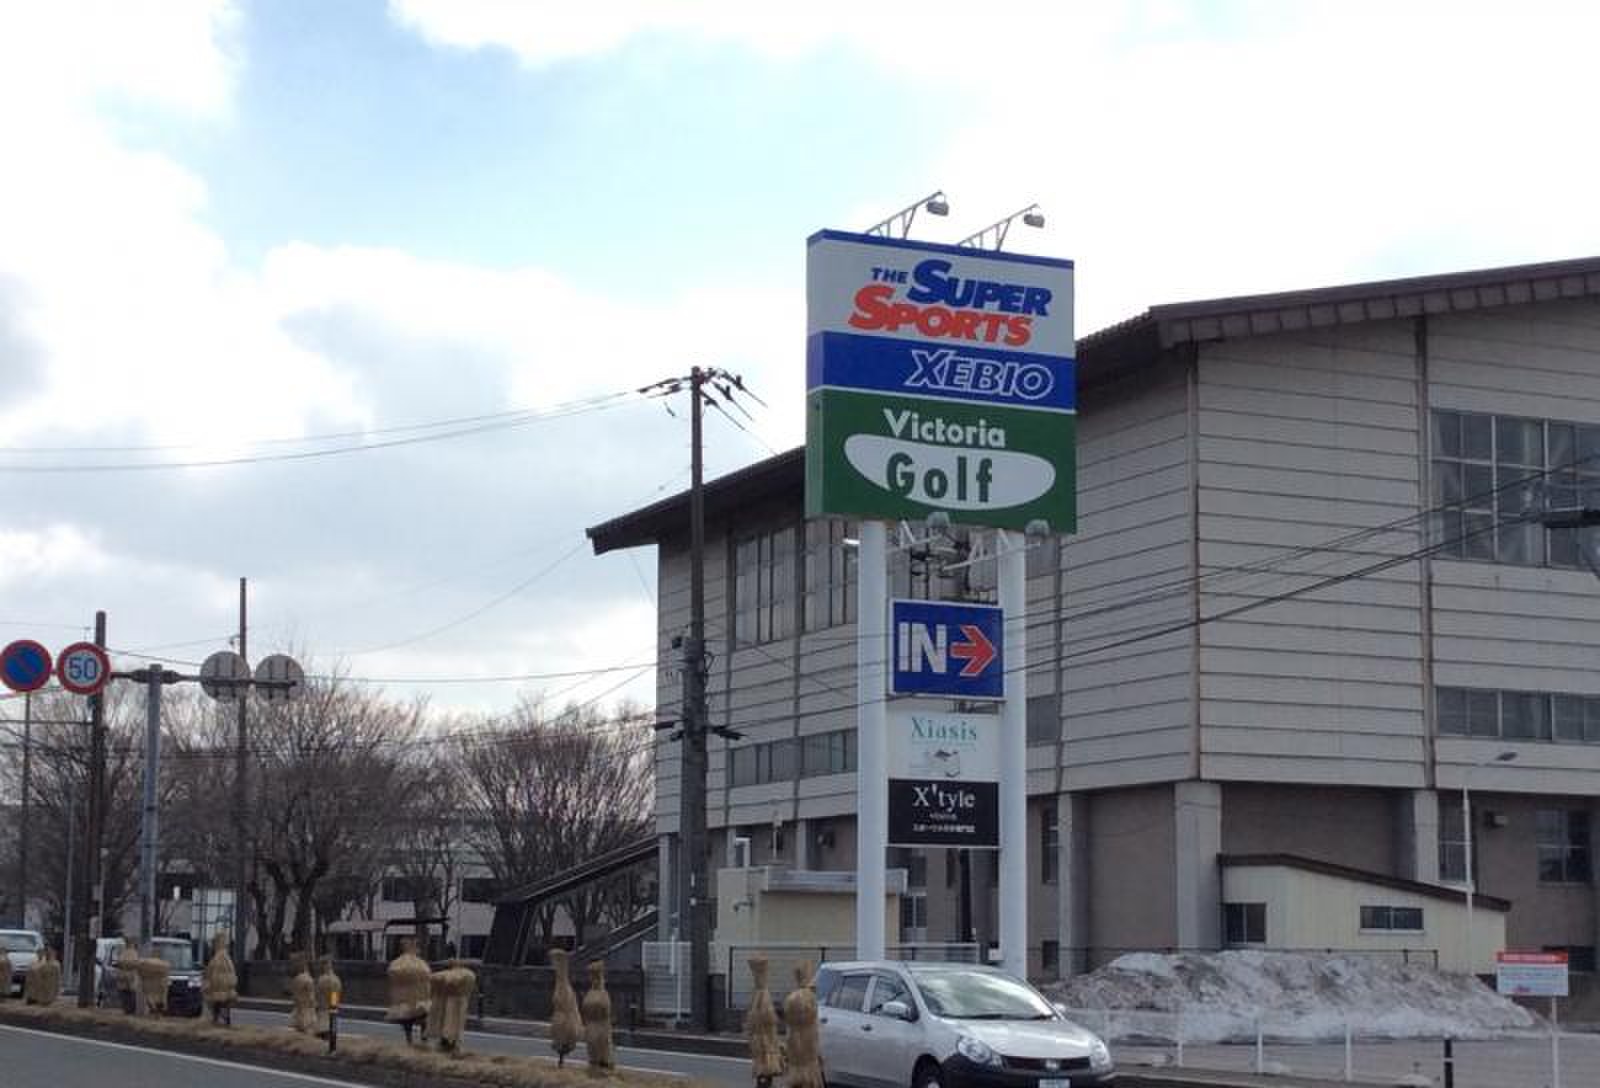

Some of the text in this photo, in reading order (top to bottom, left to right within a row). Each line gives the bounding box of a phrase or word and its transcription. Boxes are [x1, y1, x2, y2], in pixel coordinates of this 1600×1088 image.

[871, 259, 1053, 317] THE SUPER
[848, 284, 1033, 347] SPORTS
[904, 350, 1055, 400] XEBIO
[882, 408, 1006, 448] Victoria
[886, 452, 993, 503] Golf
[68, 656, 98, 680] 50
[897, 621, 948, 674] IN
[911, 716, 977, 741] Xiasis
